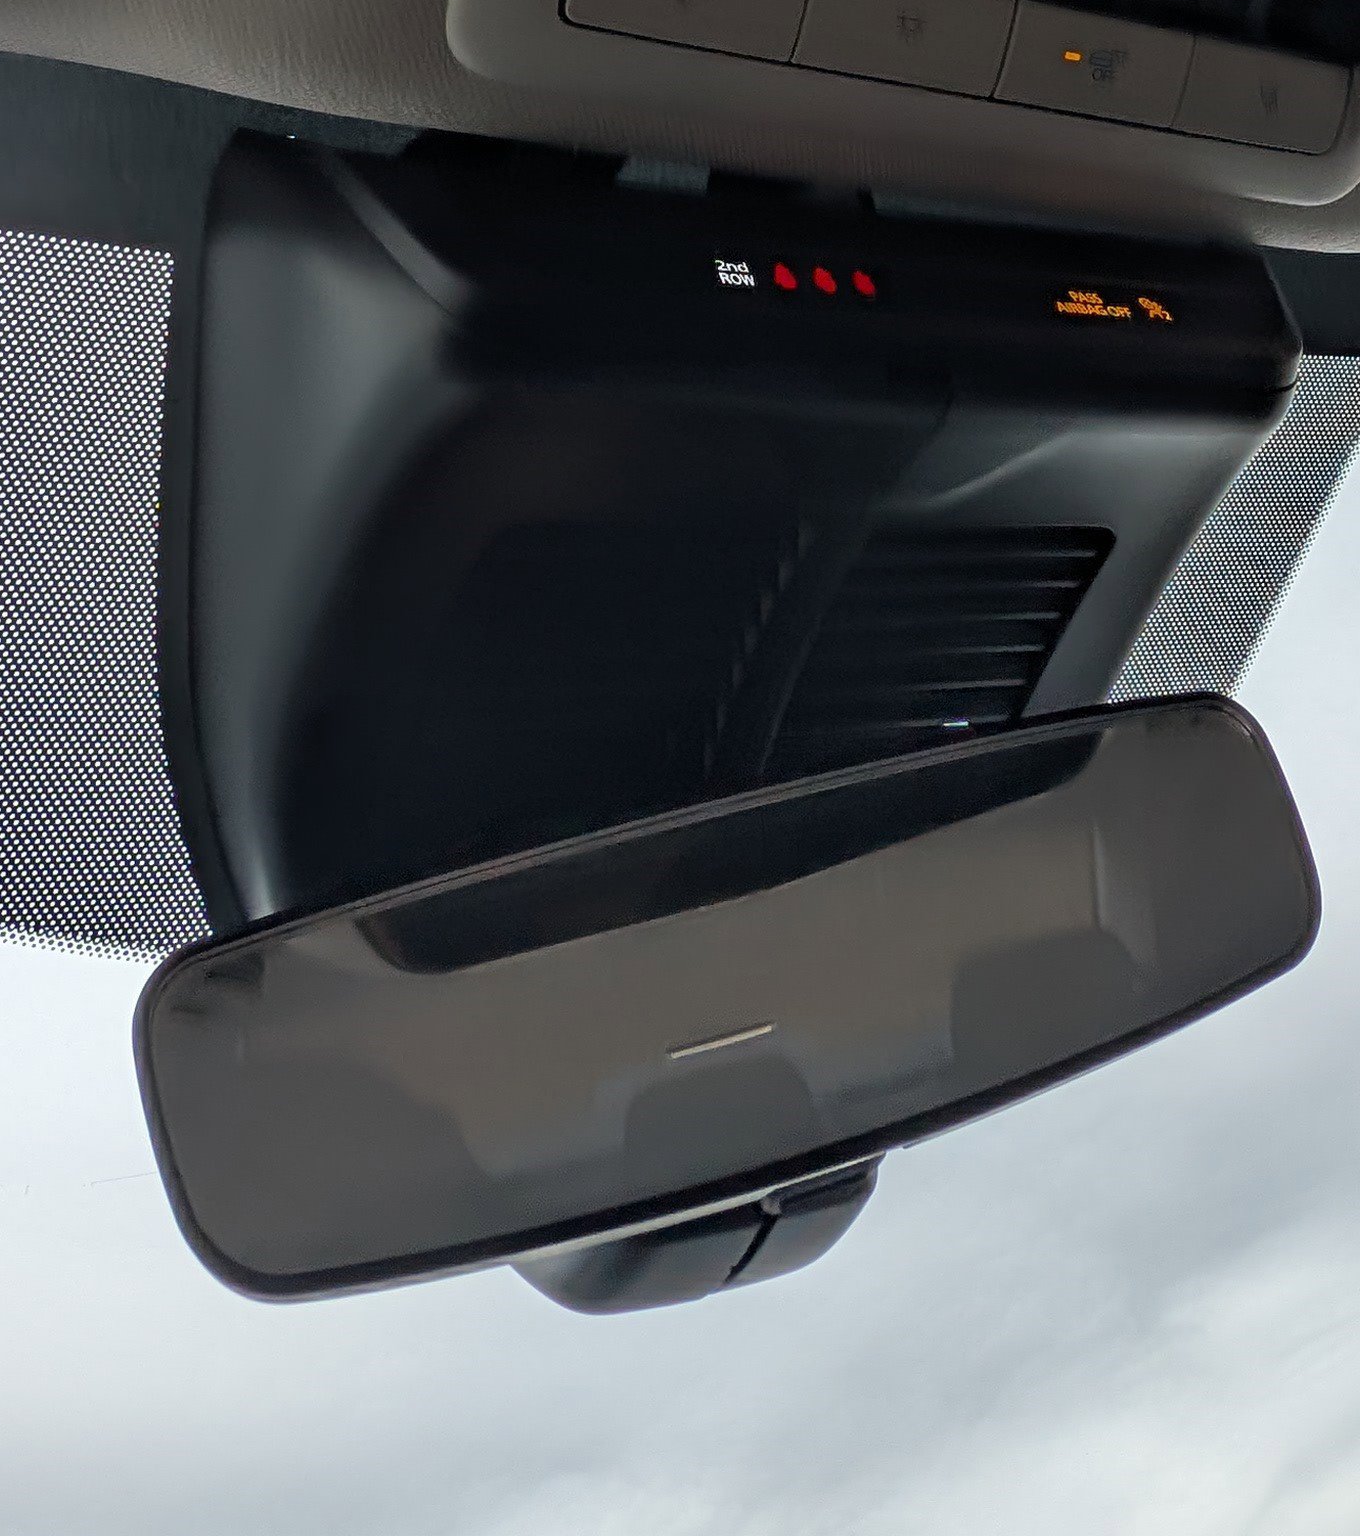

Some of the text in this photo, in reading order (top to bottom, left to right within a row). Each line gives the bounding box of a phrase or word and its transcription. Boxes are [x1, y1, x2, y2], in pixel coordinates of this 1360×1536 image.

[715, 260, 749, 272] 2nd
[719, 272, 755, 286] ROW
[1068, 291, 1103, 304] PASS
[1107, 306, 1131, 318] OFF
